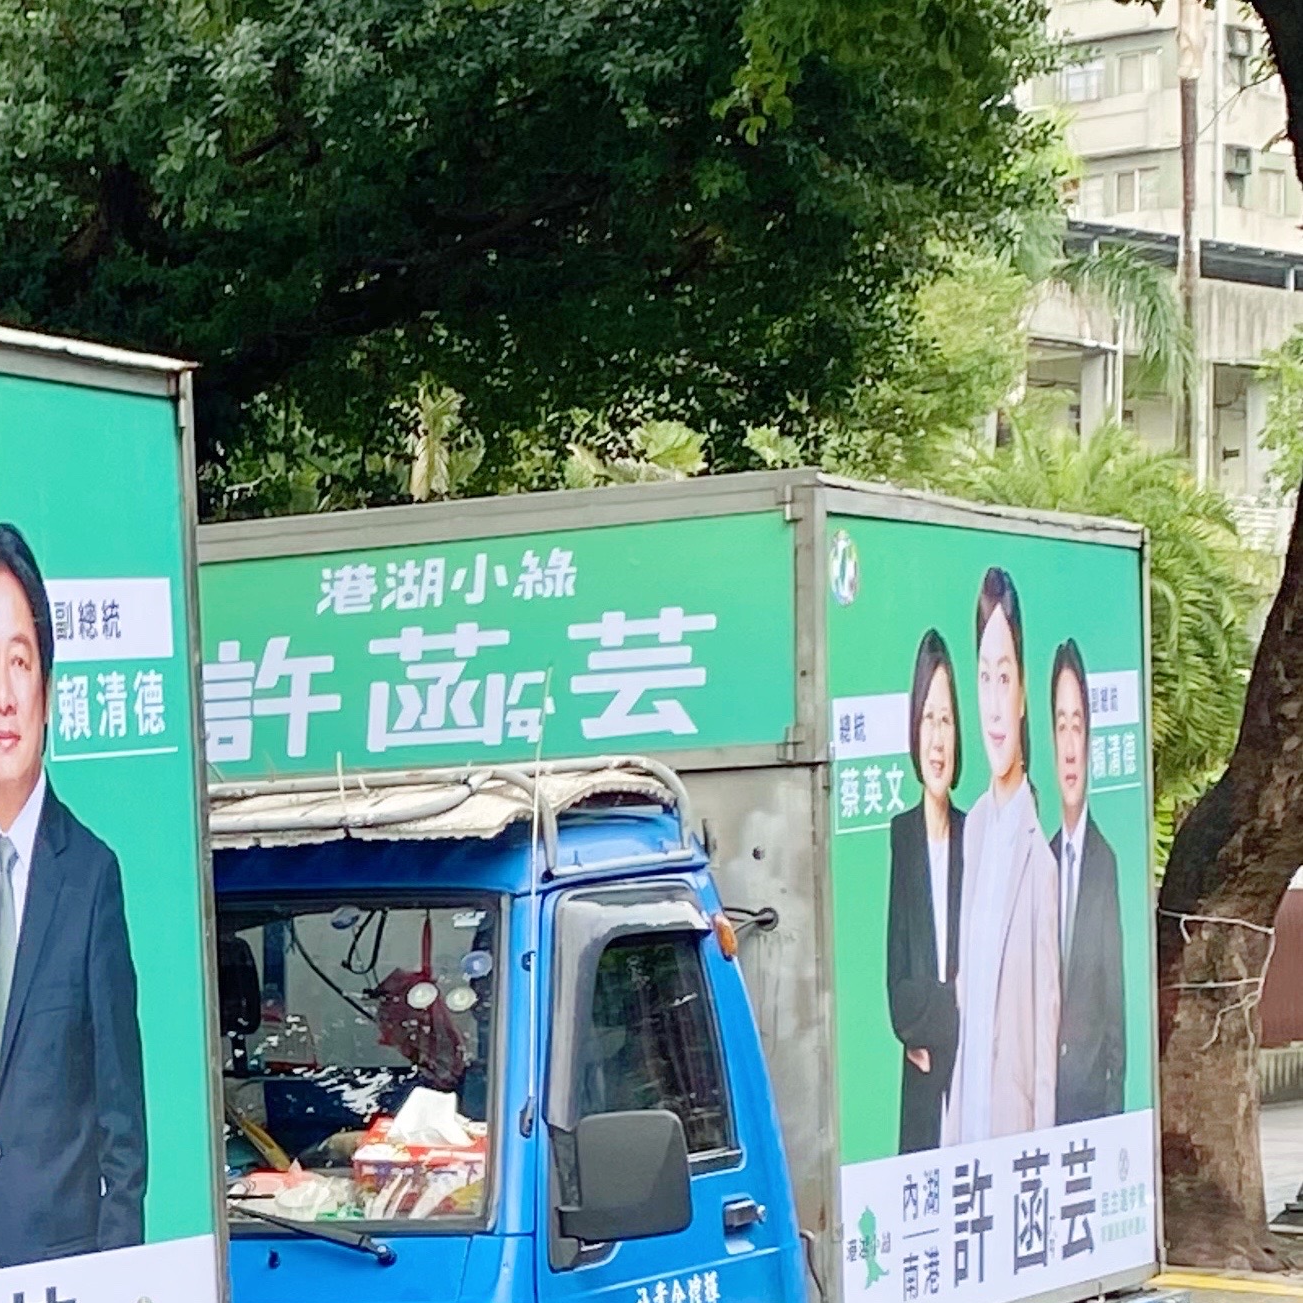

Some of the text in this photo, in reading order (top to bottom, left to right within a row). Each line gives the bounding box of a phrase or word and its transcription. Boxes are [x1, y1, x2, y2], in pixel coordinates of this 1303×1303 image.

[316, 547, 577, 615] 港湖小綠
[54, 599, 122, 640] 副總統
[57, 669, 166, 742] 賴清德
[202, 606, 716, 762] 許菡芸
[840, 762, 905, 818] 蔡英文
[952, 1138, 1096, 1288] 許菡芸
